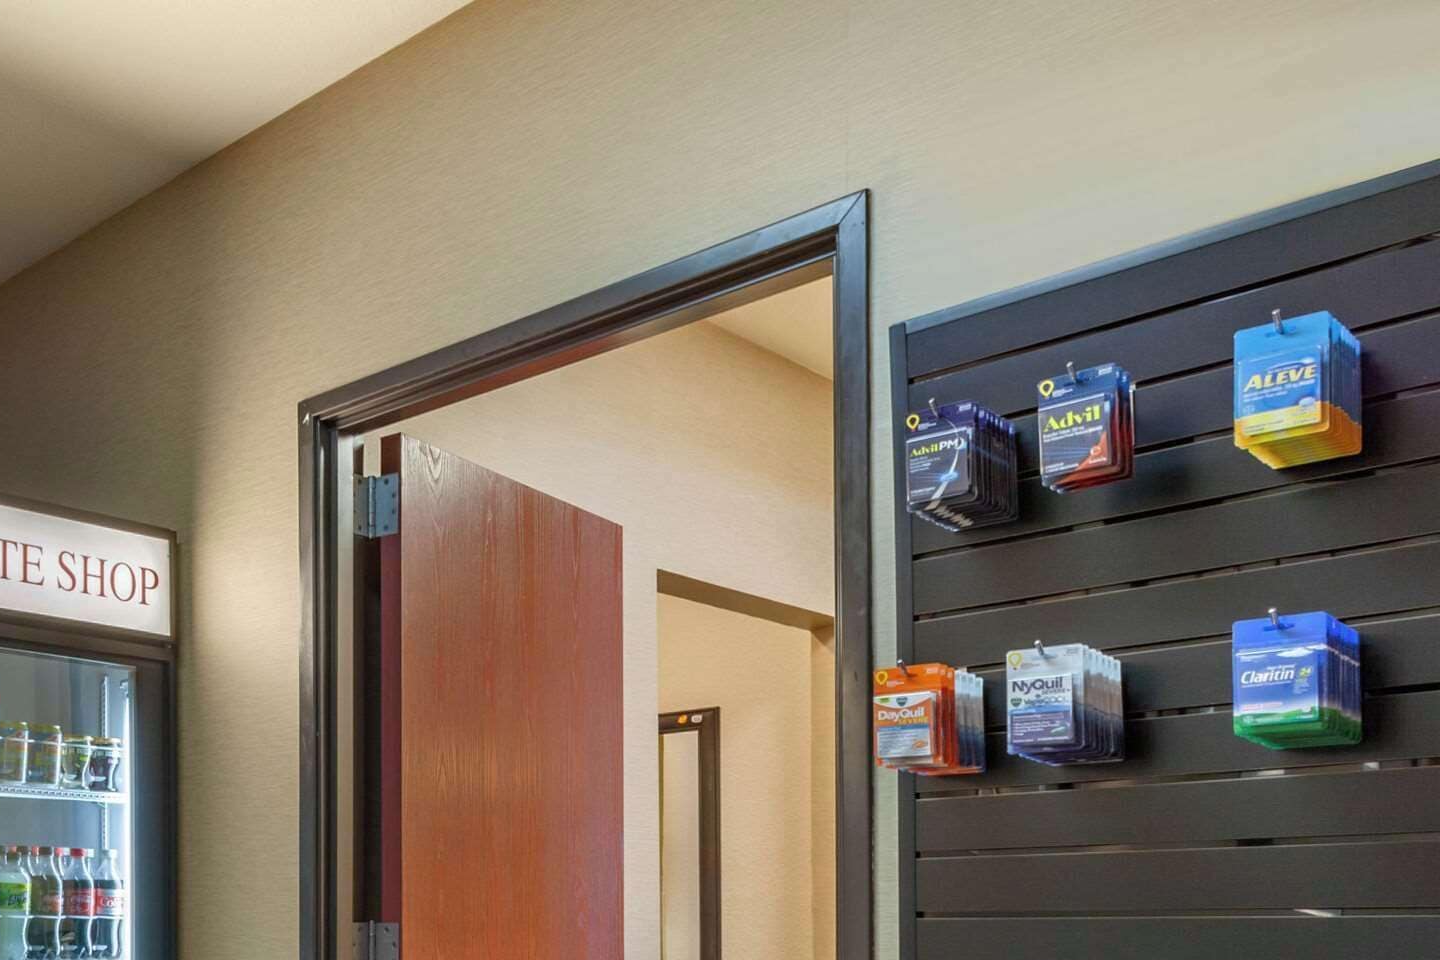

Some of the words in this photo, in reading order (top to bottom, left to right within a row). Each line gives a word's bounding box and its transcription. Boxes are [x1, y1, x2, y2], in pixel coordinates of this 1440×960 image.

[1243, 362, 1318, 393] ALEVE
[1043, 404, 1101, 432] Advil
[911, 442, 940, 458] Advil
[939, 438, 959, 451] PM
[57, 550, 160, 606] SHOP
[1240, 664, 1296, 685] Claritin
[1012, 676, 1063, 695] NyQuil
[878, 706, 925, 721] DayQuil
